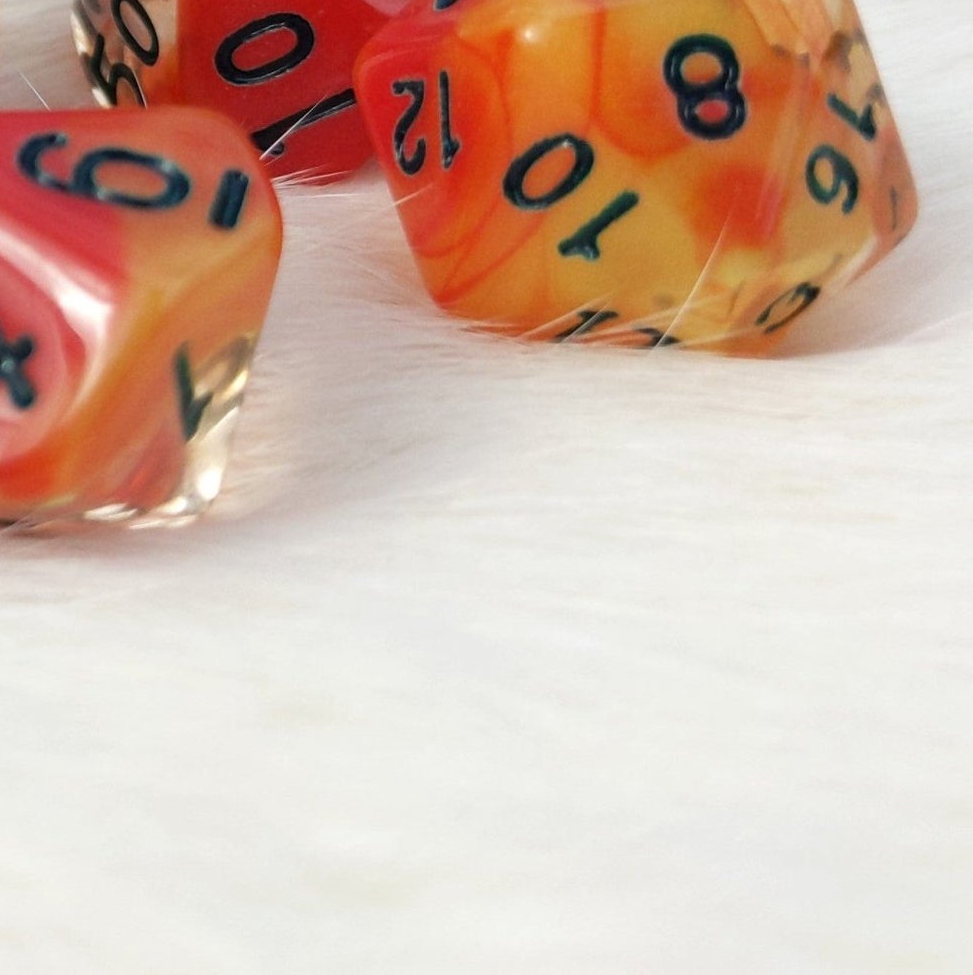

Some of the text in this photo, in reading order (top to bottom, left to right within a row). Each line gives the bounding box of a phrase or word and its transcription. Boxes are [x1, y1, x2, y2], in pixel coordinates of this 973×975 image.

[392, 70, 462, 177] 12
[663, 34, 747, 142] 8
[502, 132, 640, 262] 10
